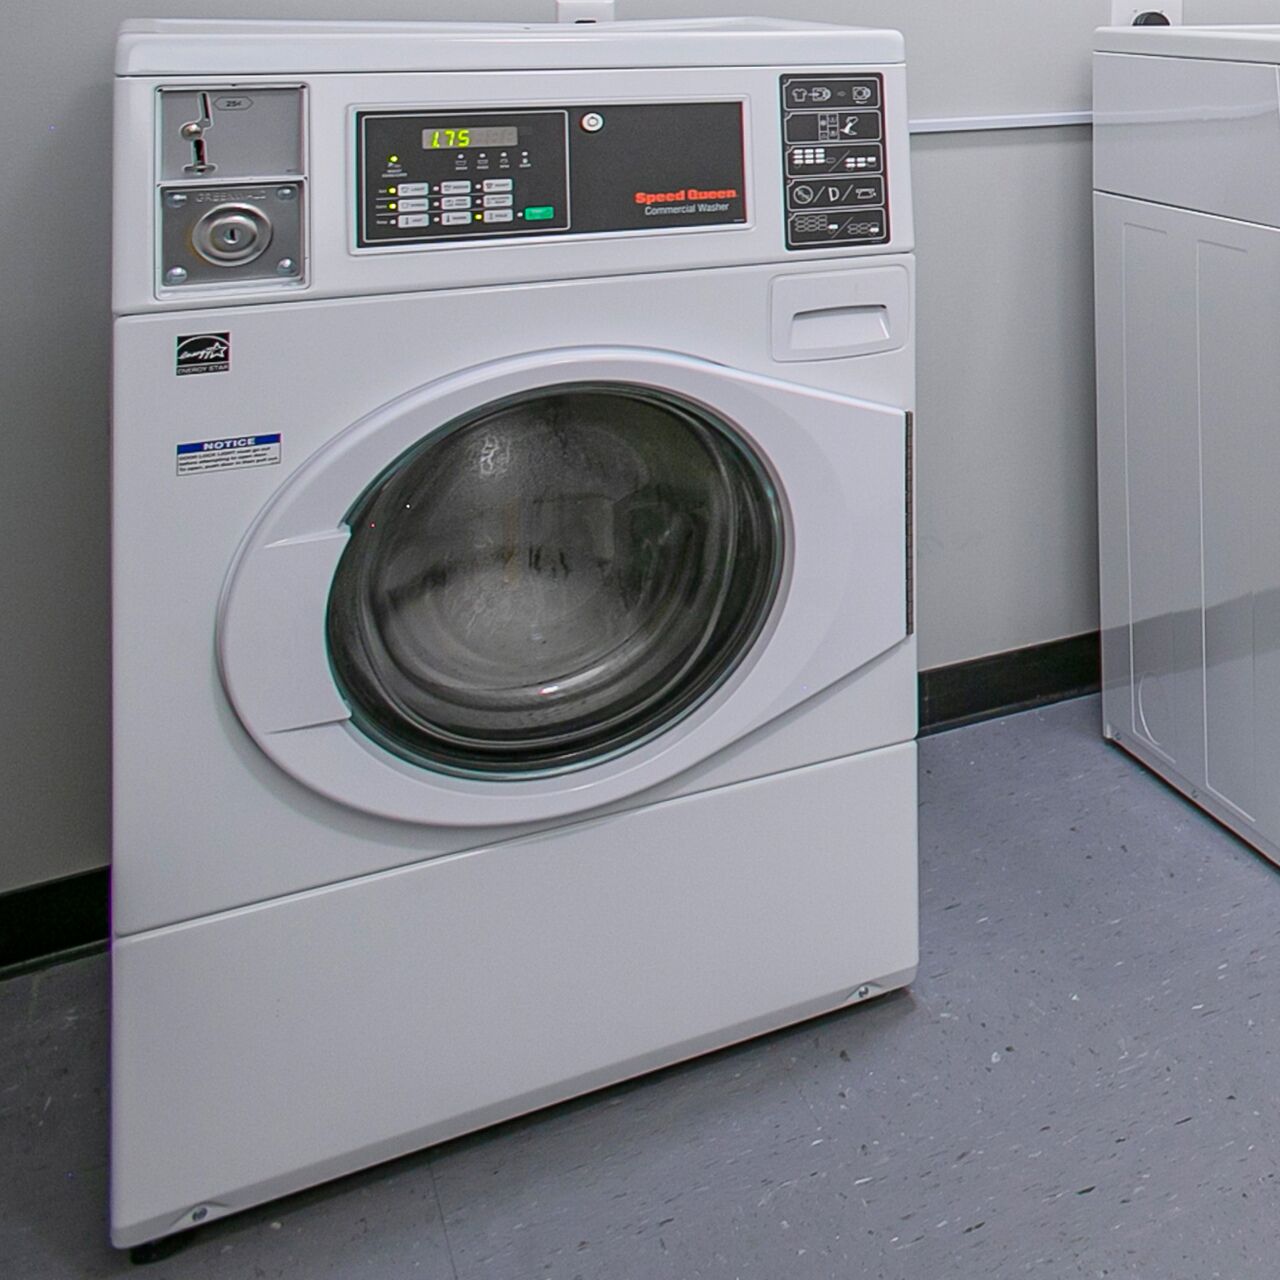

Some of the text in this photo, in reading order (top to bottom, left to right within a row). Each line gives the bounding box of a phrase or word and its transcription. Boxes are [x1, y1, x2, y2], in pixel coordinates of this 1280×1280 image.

[431, 129, 470, 149] 1.75
[634, 188, 737, 205] Speed Queen
[644, 202, 730, 216] Commercial Washer
[202, 437, 256, 451] NOTICE
